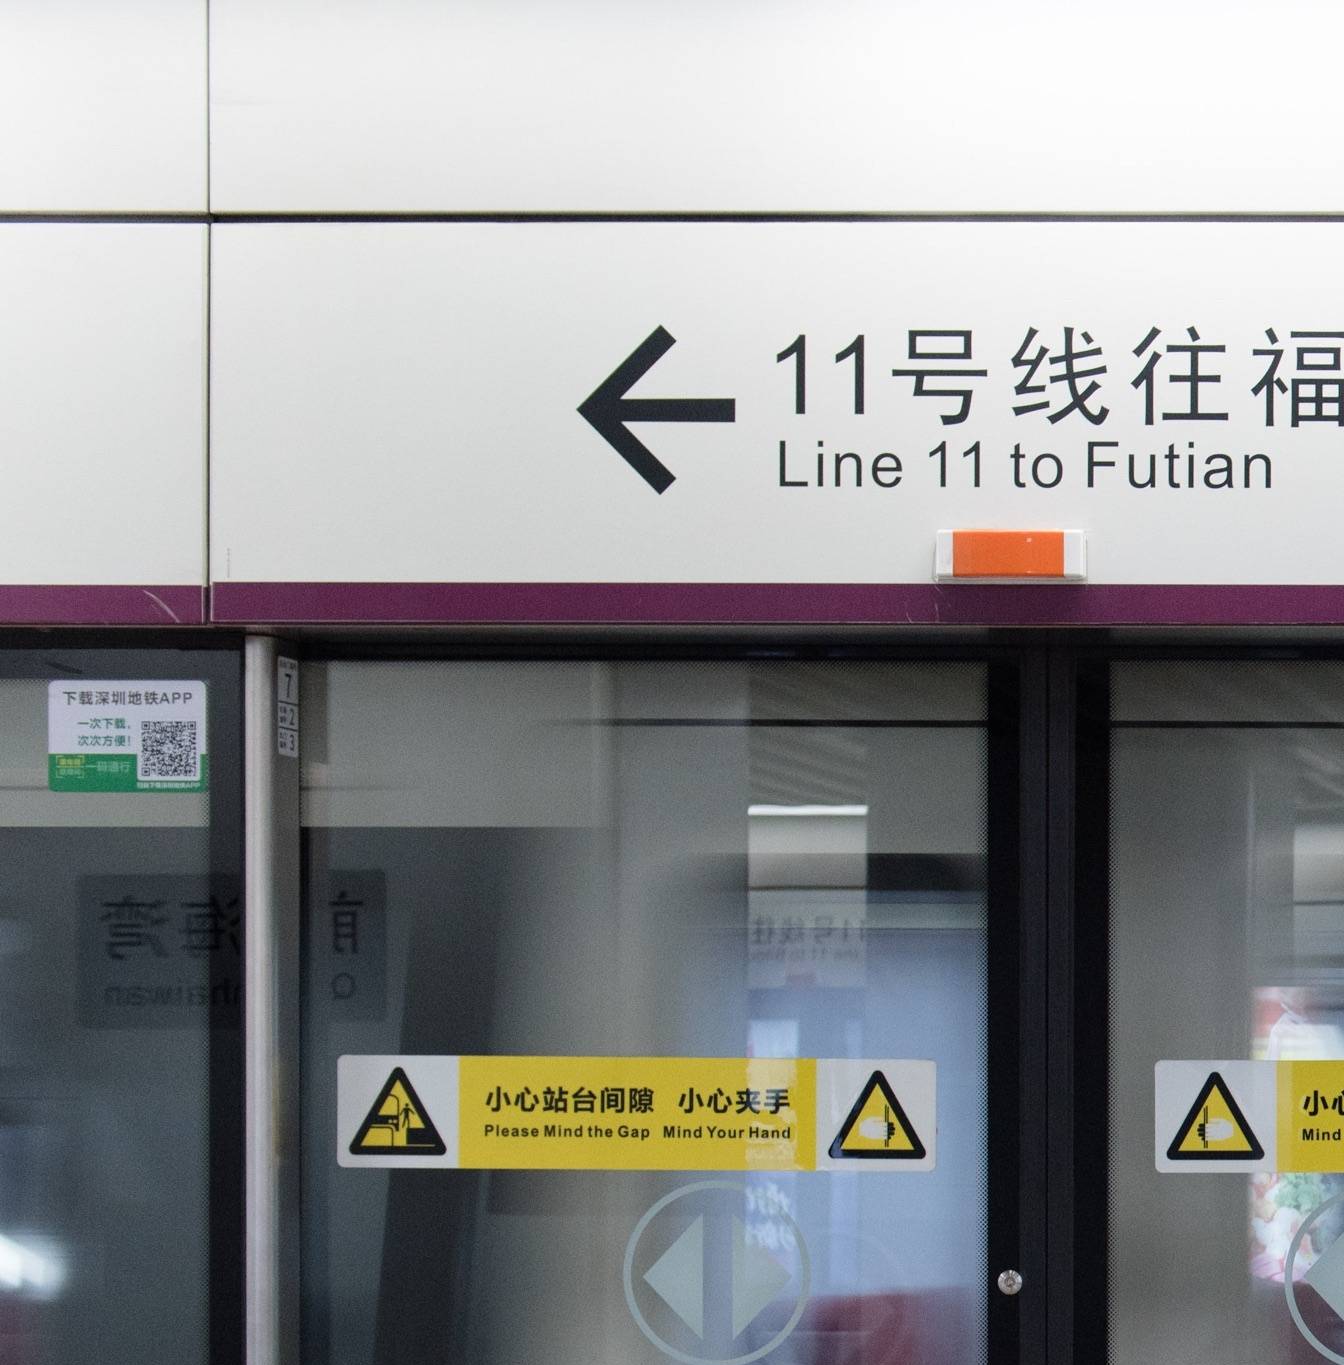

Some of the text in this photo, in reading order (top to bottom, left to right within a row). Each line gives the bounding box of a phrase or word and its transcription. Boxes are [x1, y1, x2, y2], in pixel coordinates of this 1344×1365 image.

[778, 440, 1273, 489] Line 11 to Futian
[63, 690, 193, 706] 下载深圳地铁APP
[485, 1086, 791, 1114] 小心站台间隙 小心夹手
[485, 1124, 792, 1141] Please Mind the Gap Mind Your Hand
[1301, 1127, 1343, 1142] Mind
